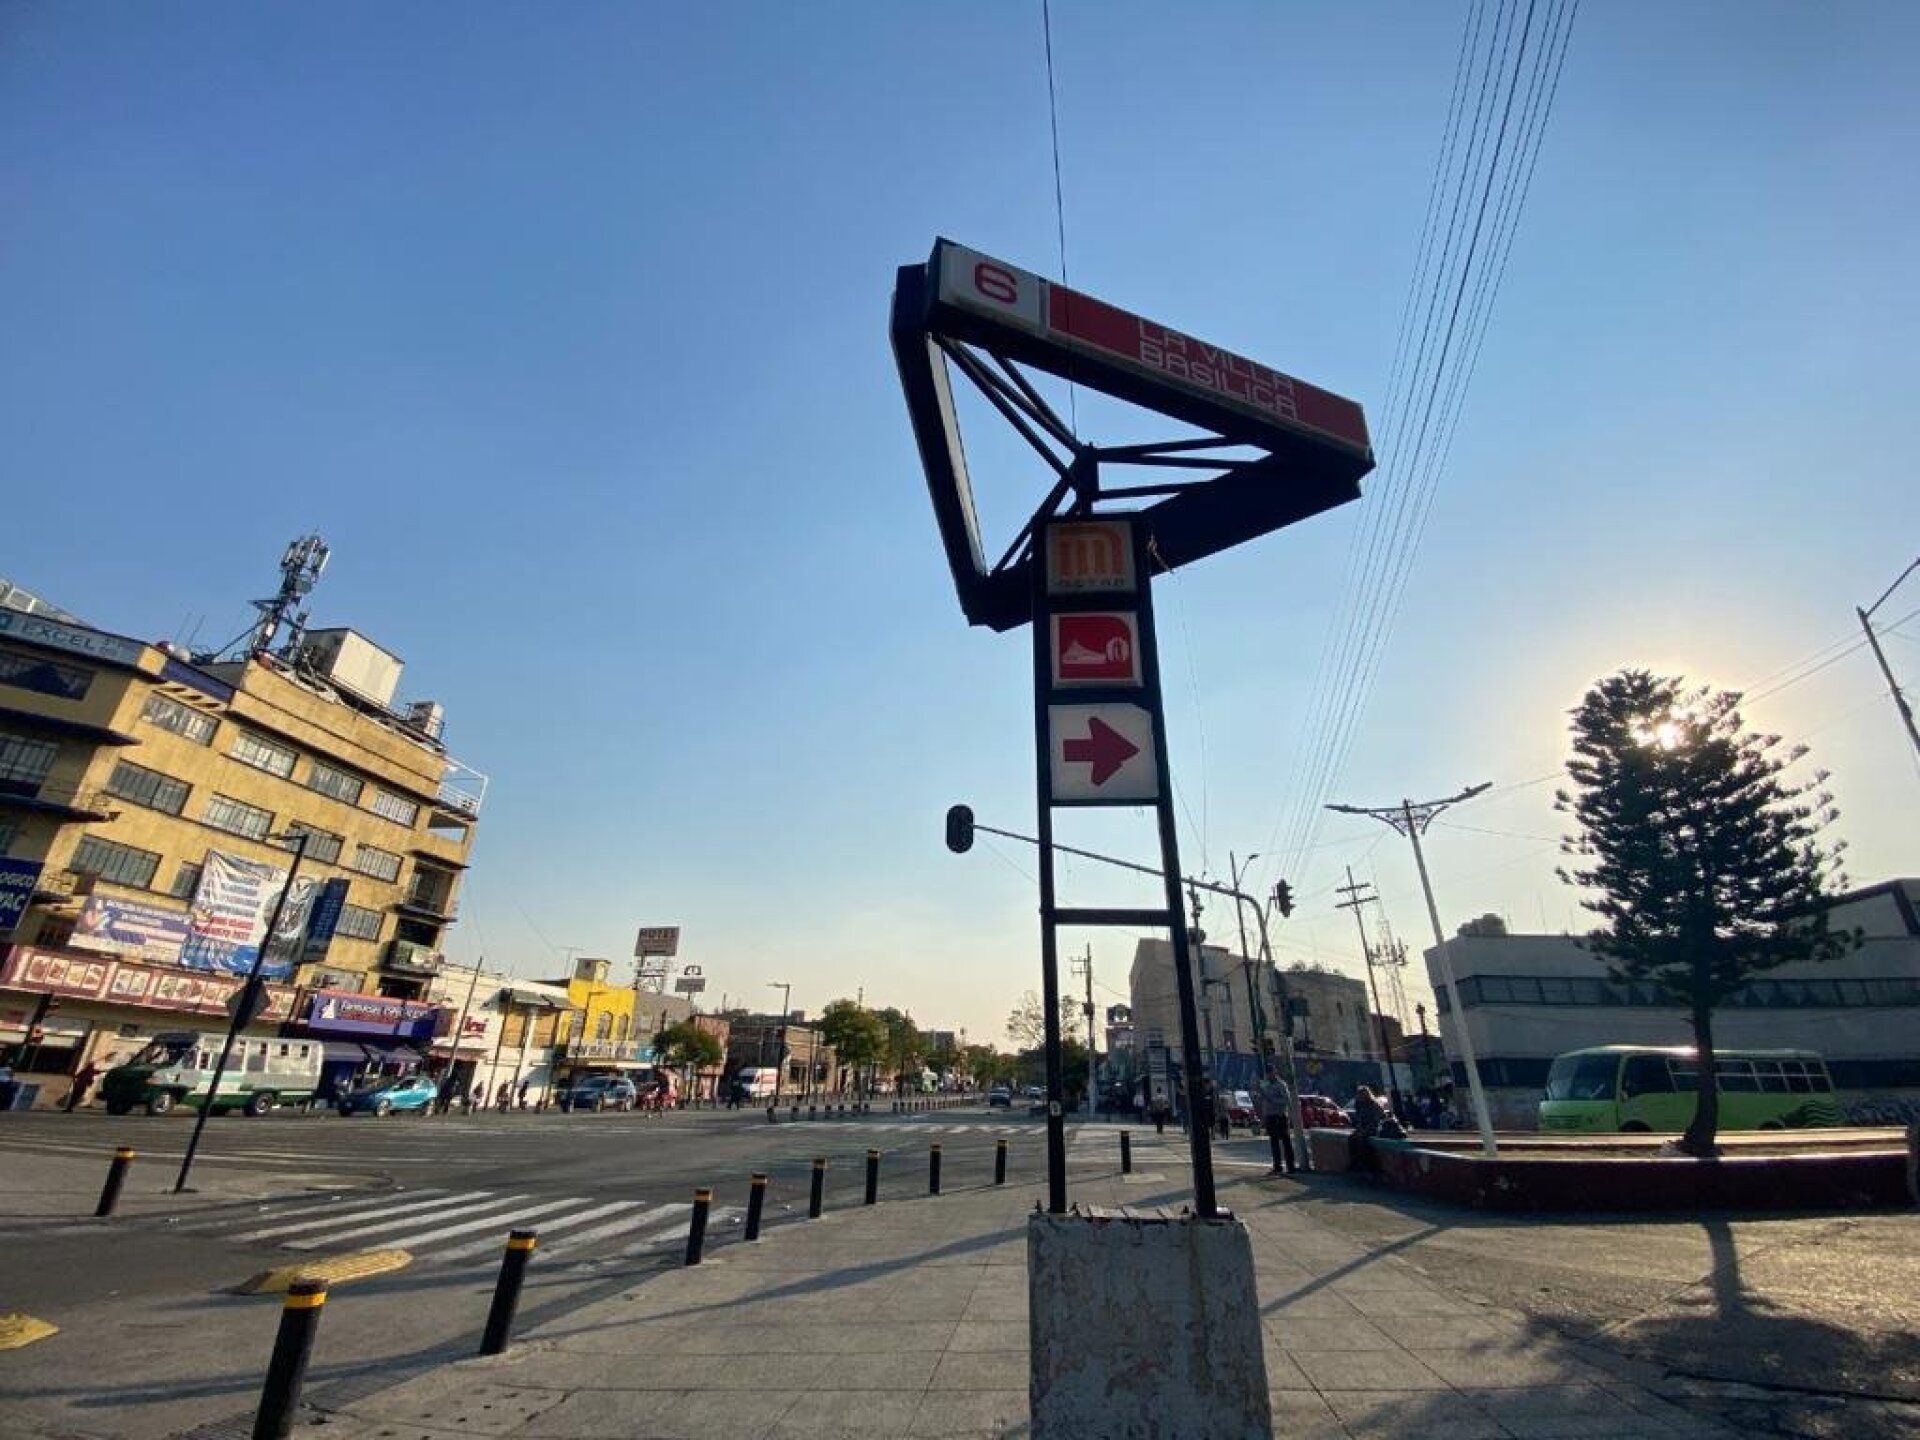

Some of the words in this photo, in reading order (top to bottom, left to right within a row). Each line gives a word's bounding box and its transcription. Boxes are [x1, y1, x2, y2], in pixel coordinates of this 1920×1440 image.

[975, 262, 1017, 304] 6
[1139, 319, 1186, 354] LA
[1199, 344, 1295, 397] VILLA
[1139, 341, 1299, 421] BASILICA
